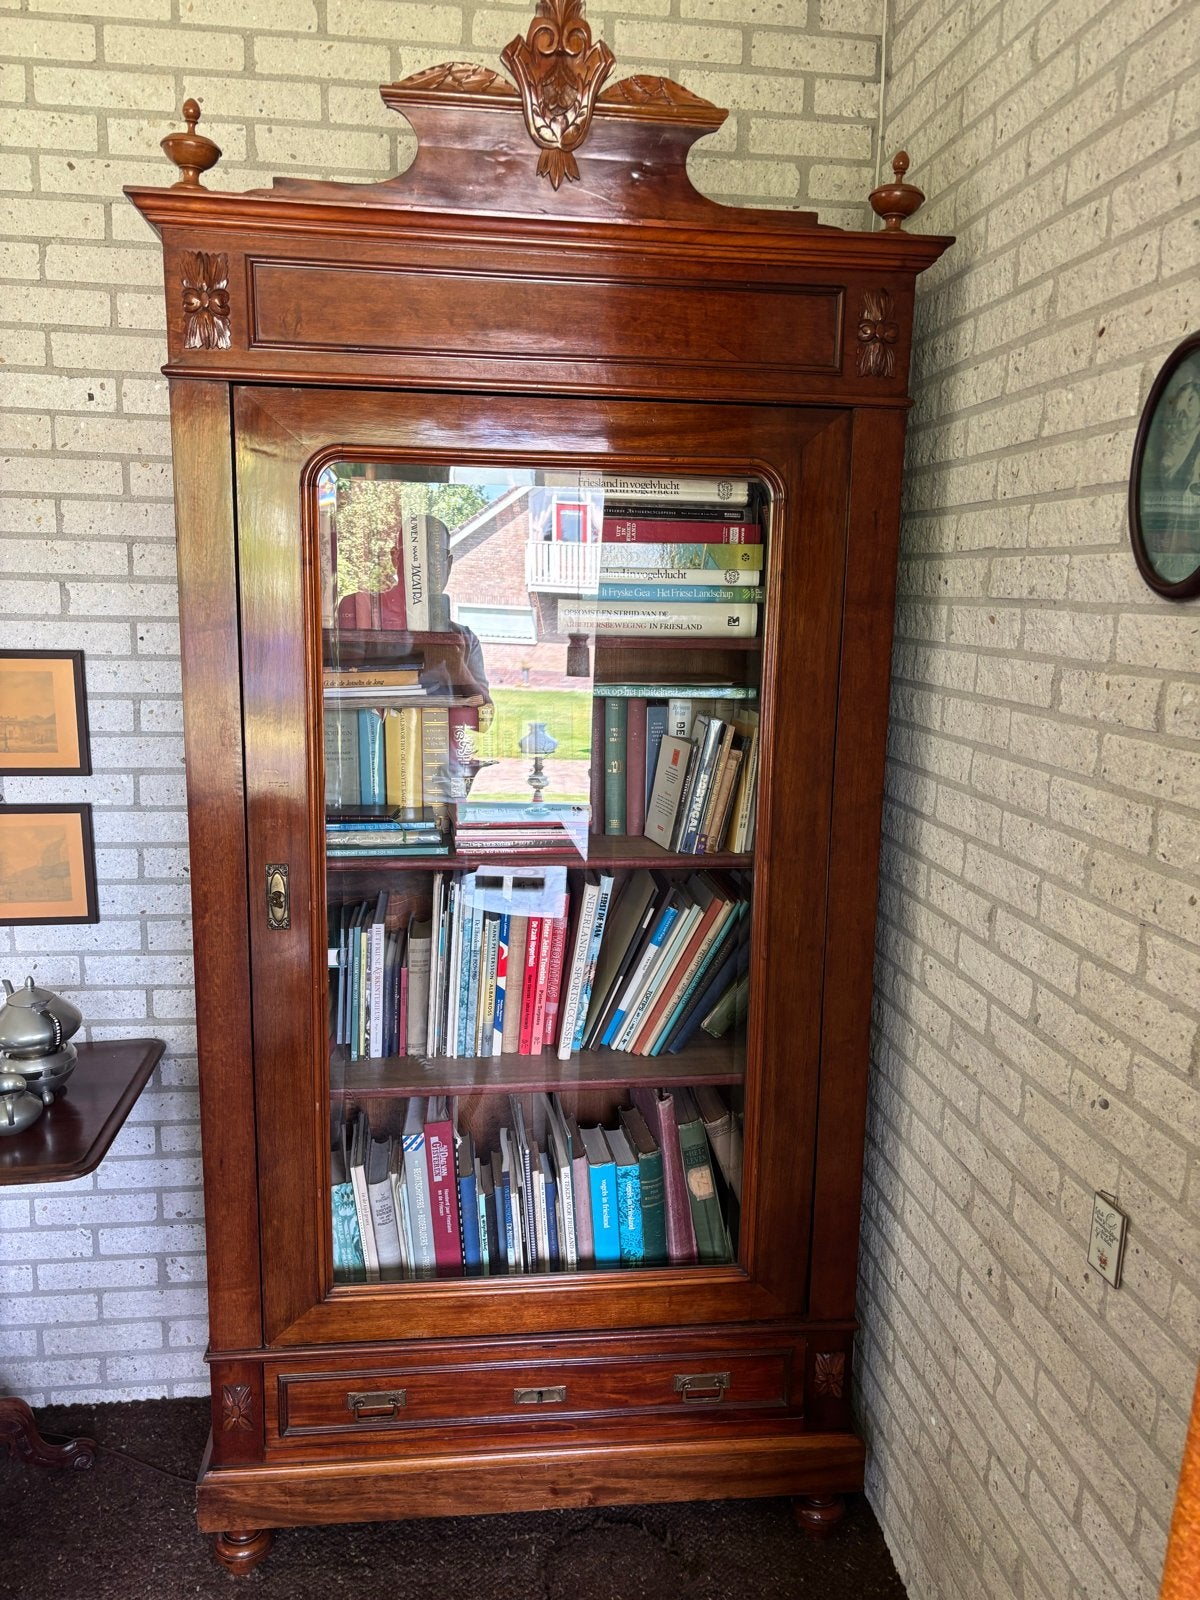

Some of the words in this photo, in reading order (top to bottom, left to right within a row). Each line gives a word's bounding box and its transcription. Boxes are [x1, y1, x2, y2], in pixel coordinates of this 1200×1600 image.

[578, 477, 617, 488] Friesland
[620, 478, 628, 488] in
[630, 480, 680, 490] vogelvlucht
[411, 563, 422, 606] JACATRA
[636, 568, 686, 580] vogelvlucht
[609, 588, 633, 599] Fryske
[634, 588, 650, 597] Gea
[657, 588, 670, 597] Het
[672, 589, 693, 598] Friese
[694, 589, 733, 599] Landschap
[612, 688, 623, 698] op
[676, 721, 685, 736] DE
[688, 774, 709, 833] PORTUGAL
[599, 893, 609, 912] EERST
[542, 919, 551, 937] Pieter
[578, 893, 596, 963] NEDERLANDSE
[597, 912, 605, 921] DE
[528, 941, 537, 967] Hogerhuis
[541, 938, 549, 956] Jelles
[693, 949, 707, 968] VECHT
[538, 957, 547, 985] Troelstra
[373, 967, 382, 1020] KERKINTERIEUR
[562, 966, 583, 1049] SPORTSUCCESSEN
[432, 1141, 442, 1177] GISTEREN
[414, 1168, 424, 1208] BEURTSCHIPPERS
[602, 1204, 610, 1228] friesland
[627, 1205, 635, 1230] friesland
